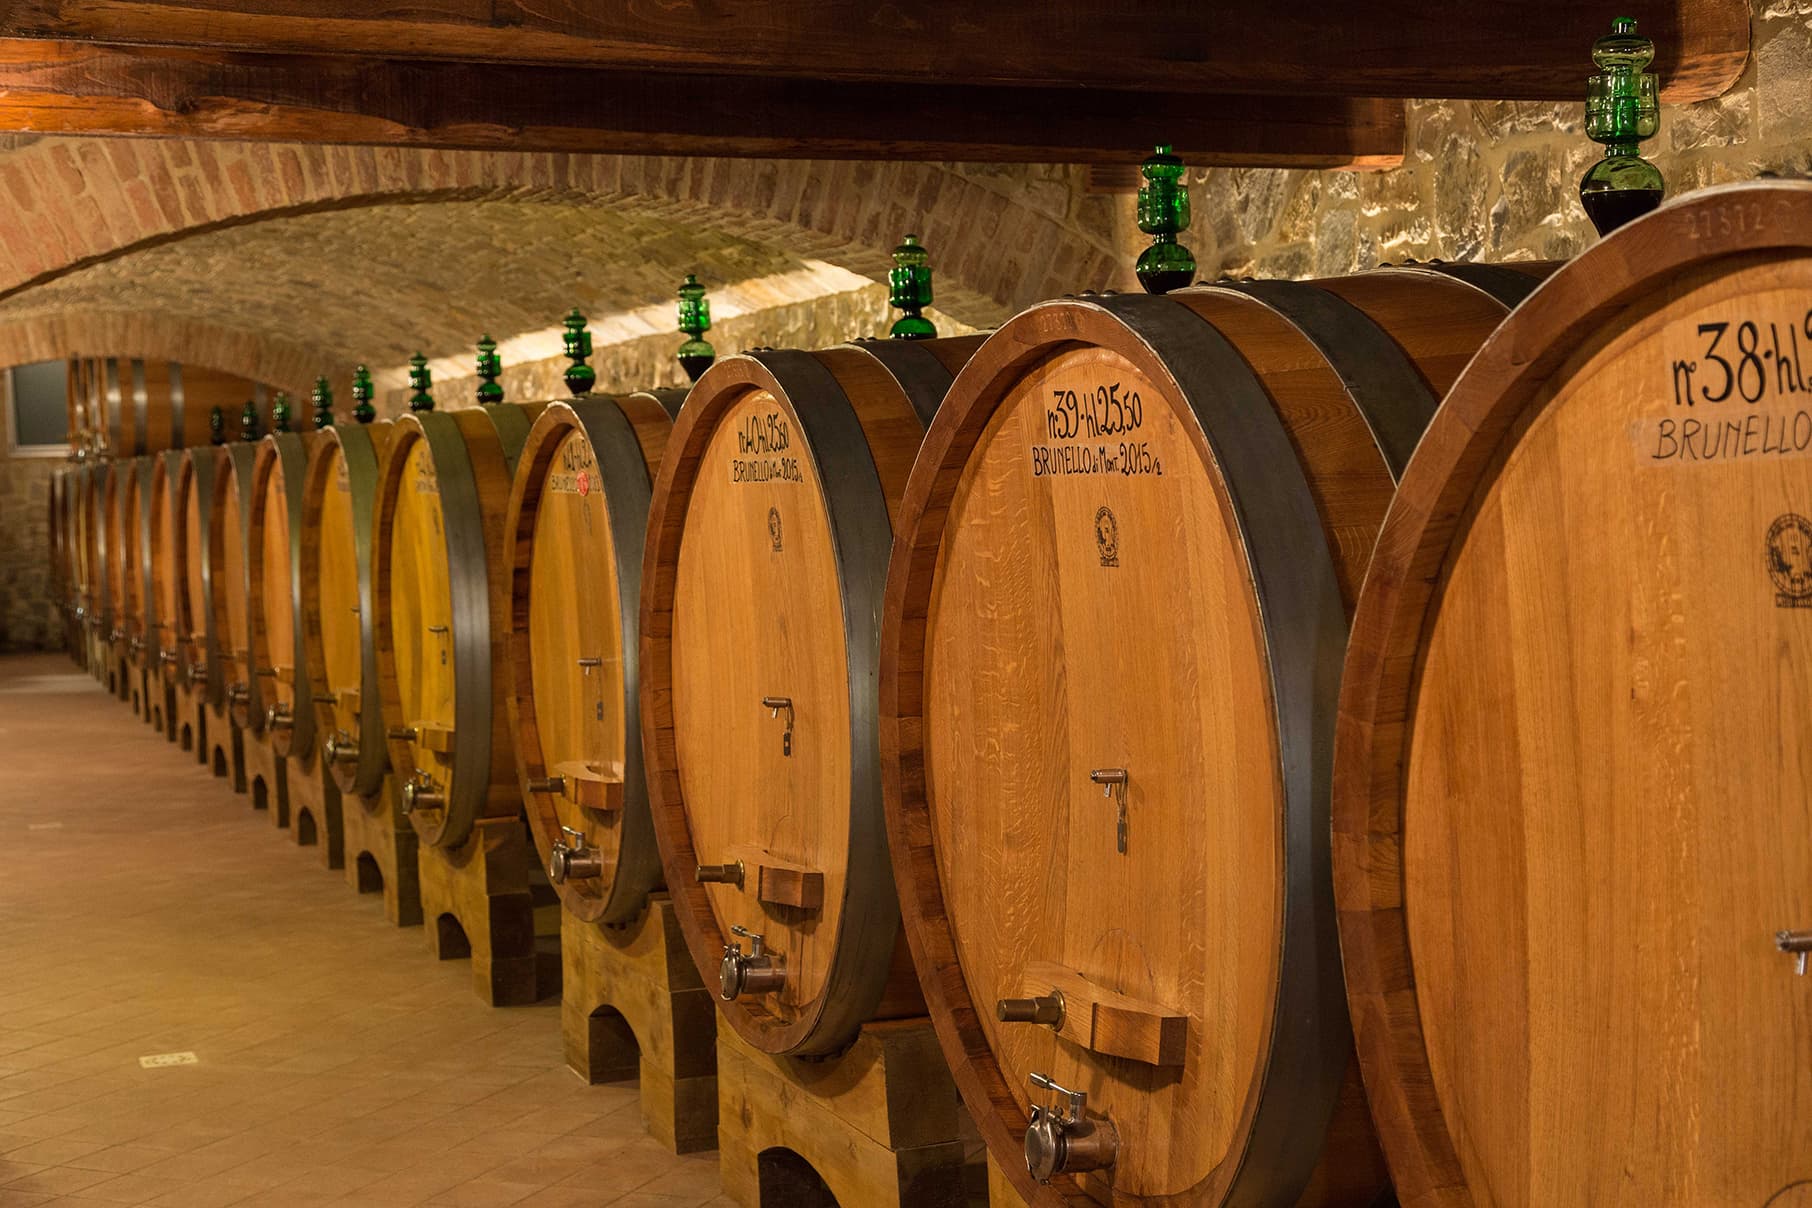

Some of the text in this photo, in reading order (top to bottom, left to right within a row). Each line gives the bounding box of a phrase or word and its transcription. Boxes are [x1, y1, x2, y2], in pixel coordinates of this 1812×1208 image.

[1652, 411, 1812, 460] BRUNELLO
[733, 459, 769, 483] BRUNELLO
[1032, 446, 1091, 476] BRUNELLO
